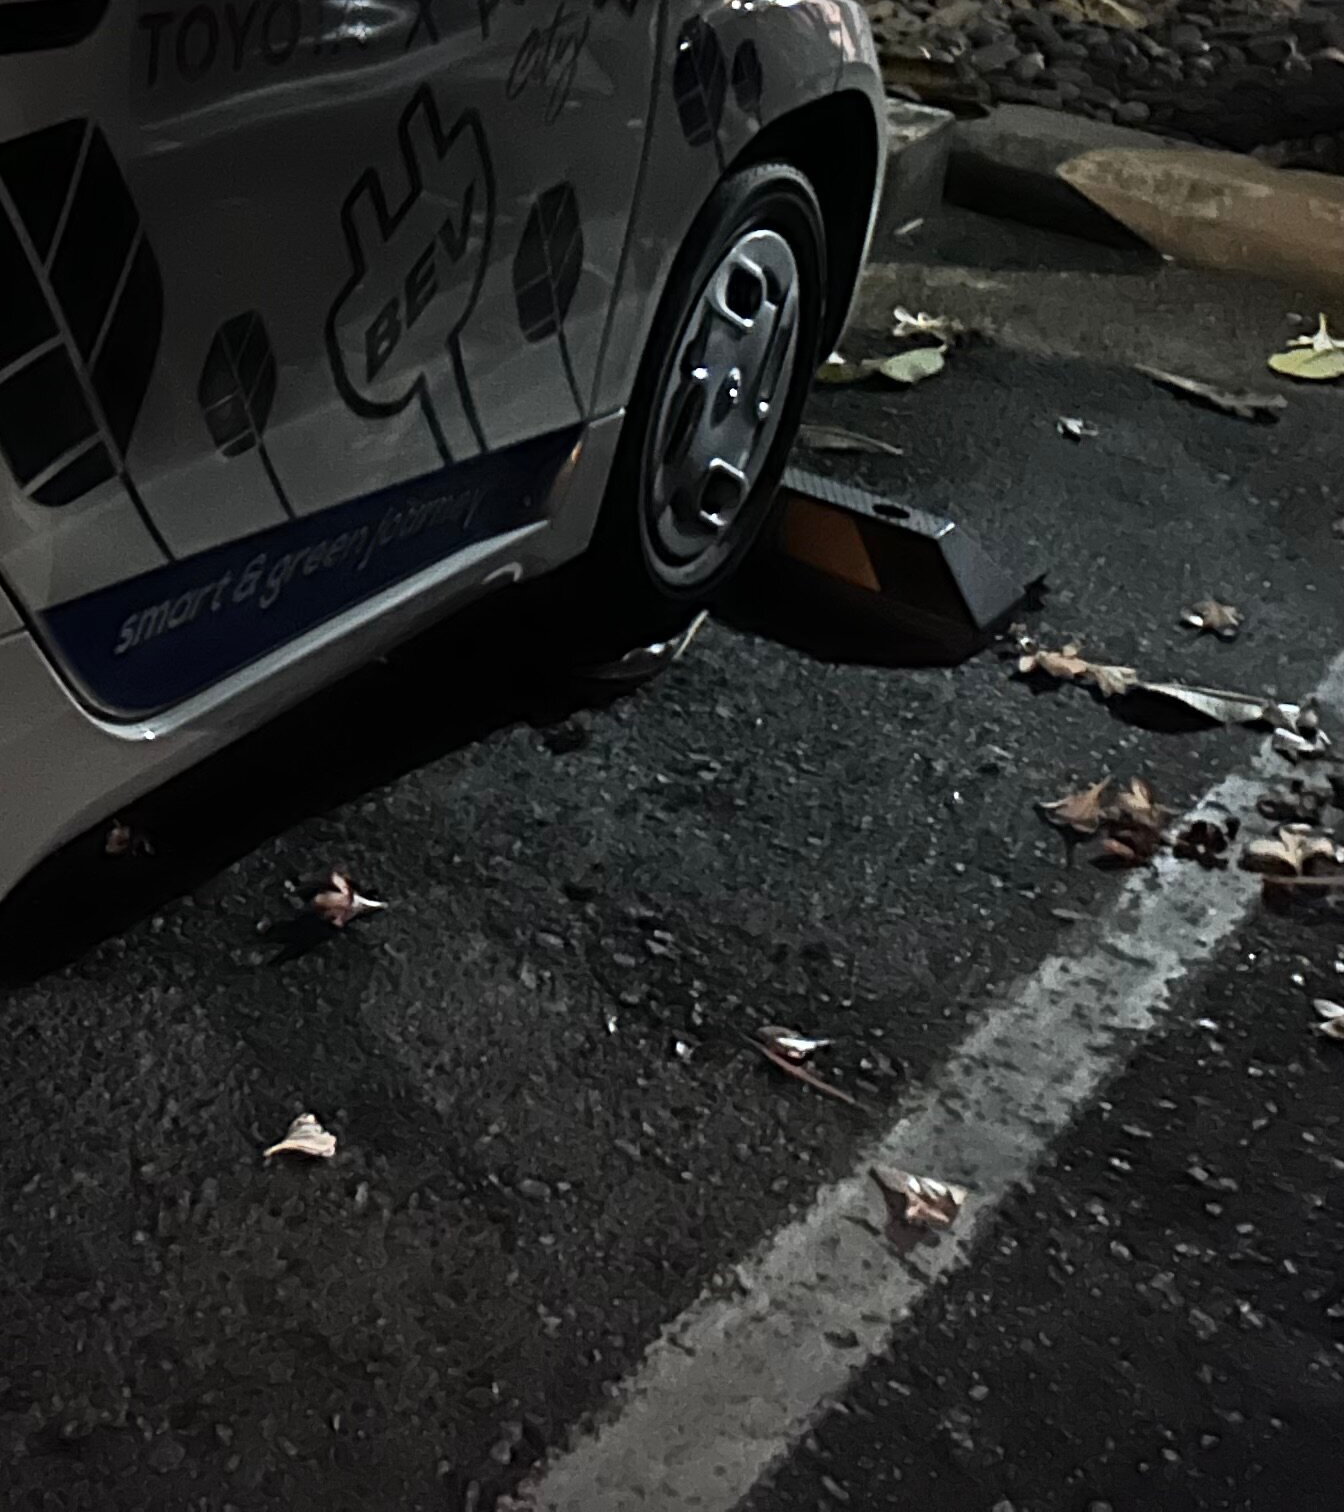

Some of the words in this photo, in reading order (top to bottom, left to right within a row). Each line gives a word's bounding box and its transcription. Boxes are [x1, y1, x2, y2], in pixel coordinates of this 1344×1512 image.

[364, 179, 477, 384] BEV
[113, 570, 233, 654] smart
[232, 553, 268, 603] &
[260, 525, 368, 609] green
